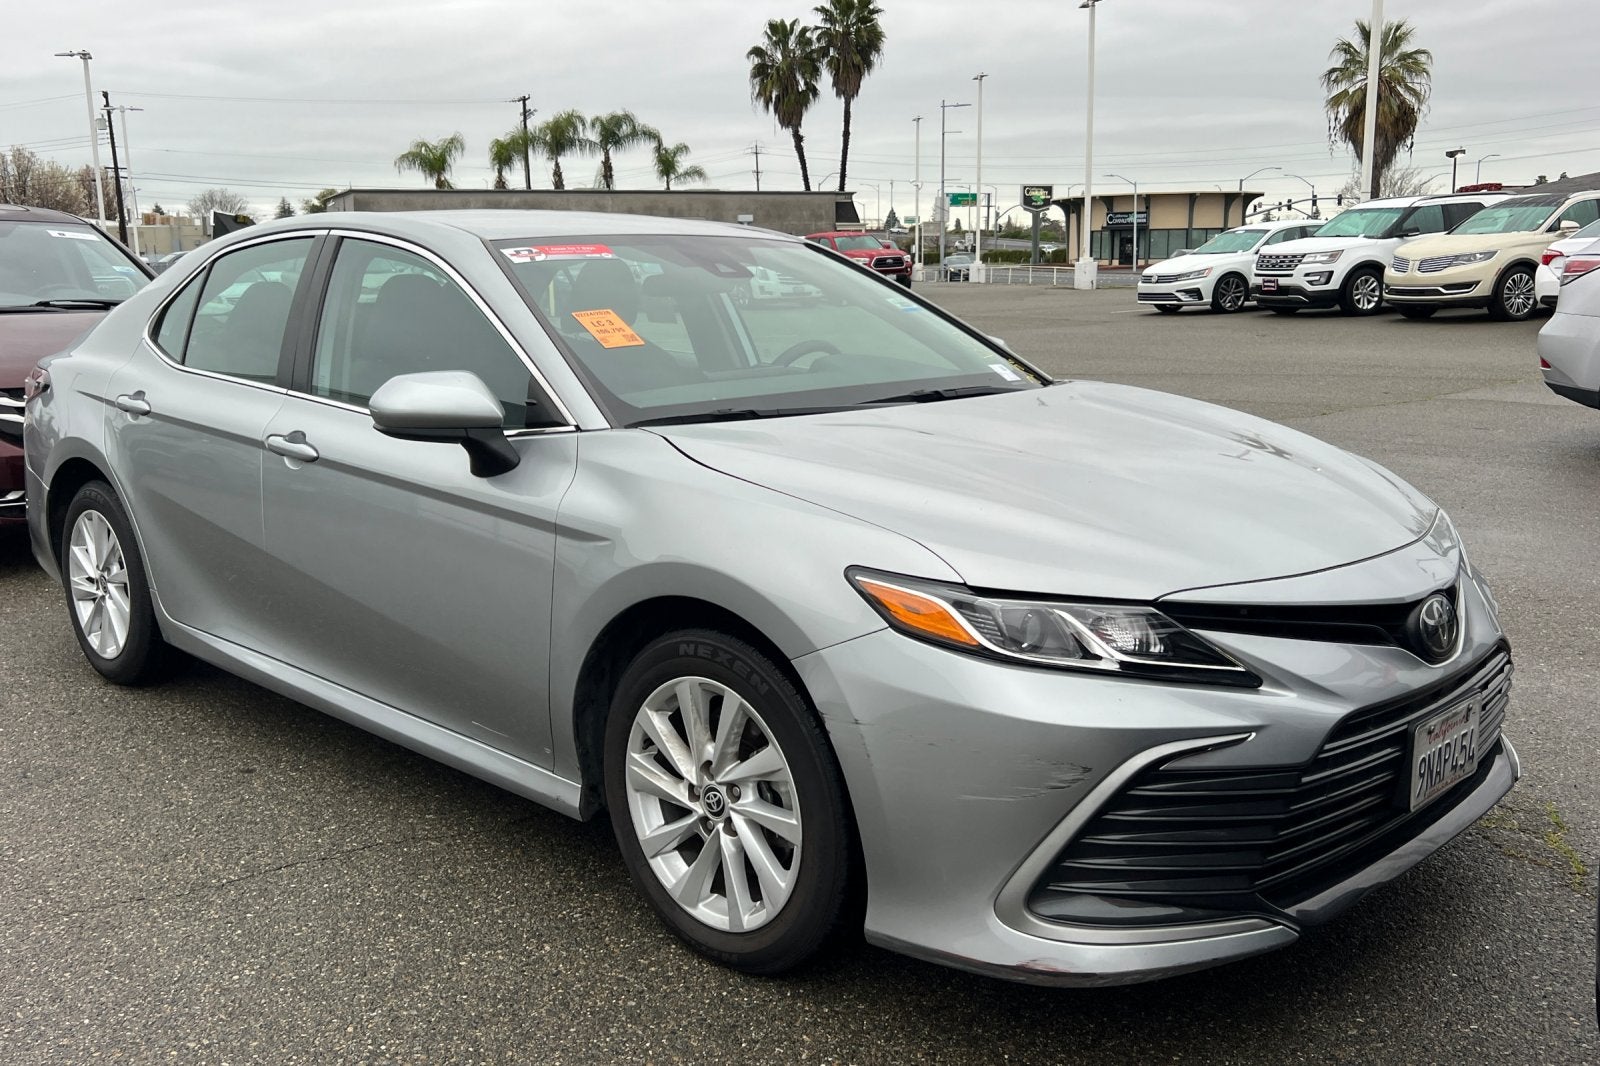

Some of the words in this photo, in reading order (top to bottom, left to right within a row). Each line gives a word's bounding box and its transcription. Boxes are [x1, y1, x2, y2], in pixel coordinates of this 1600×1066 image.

[590, 320, 605, 328] LC
[679, 643, 770, 696] NEXEN
[1416, 726, 1475, 798] 9NAP454
